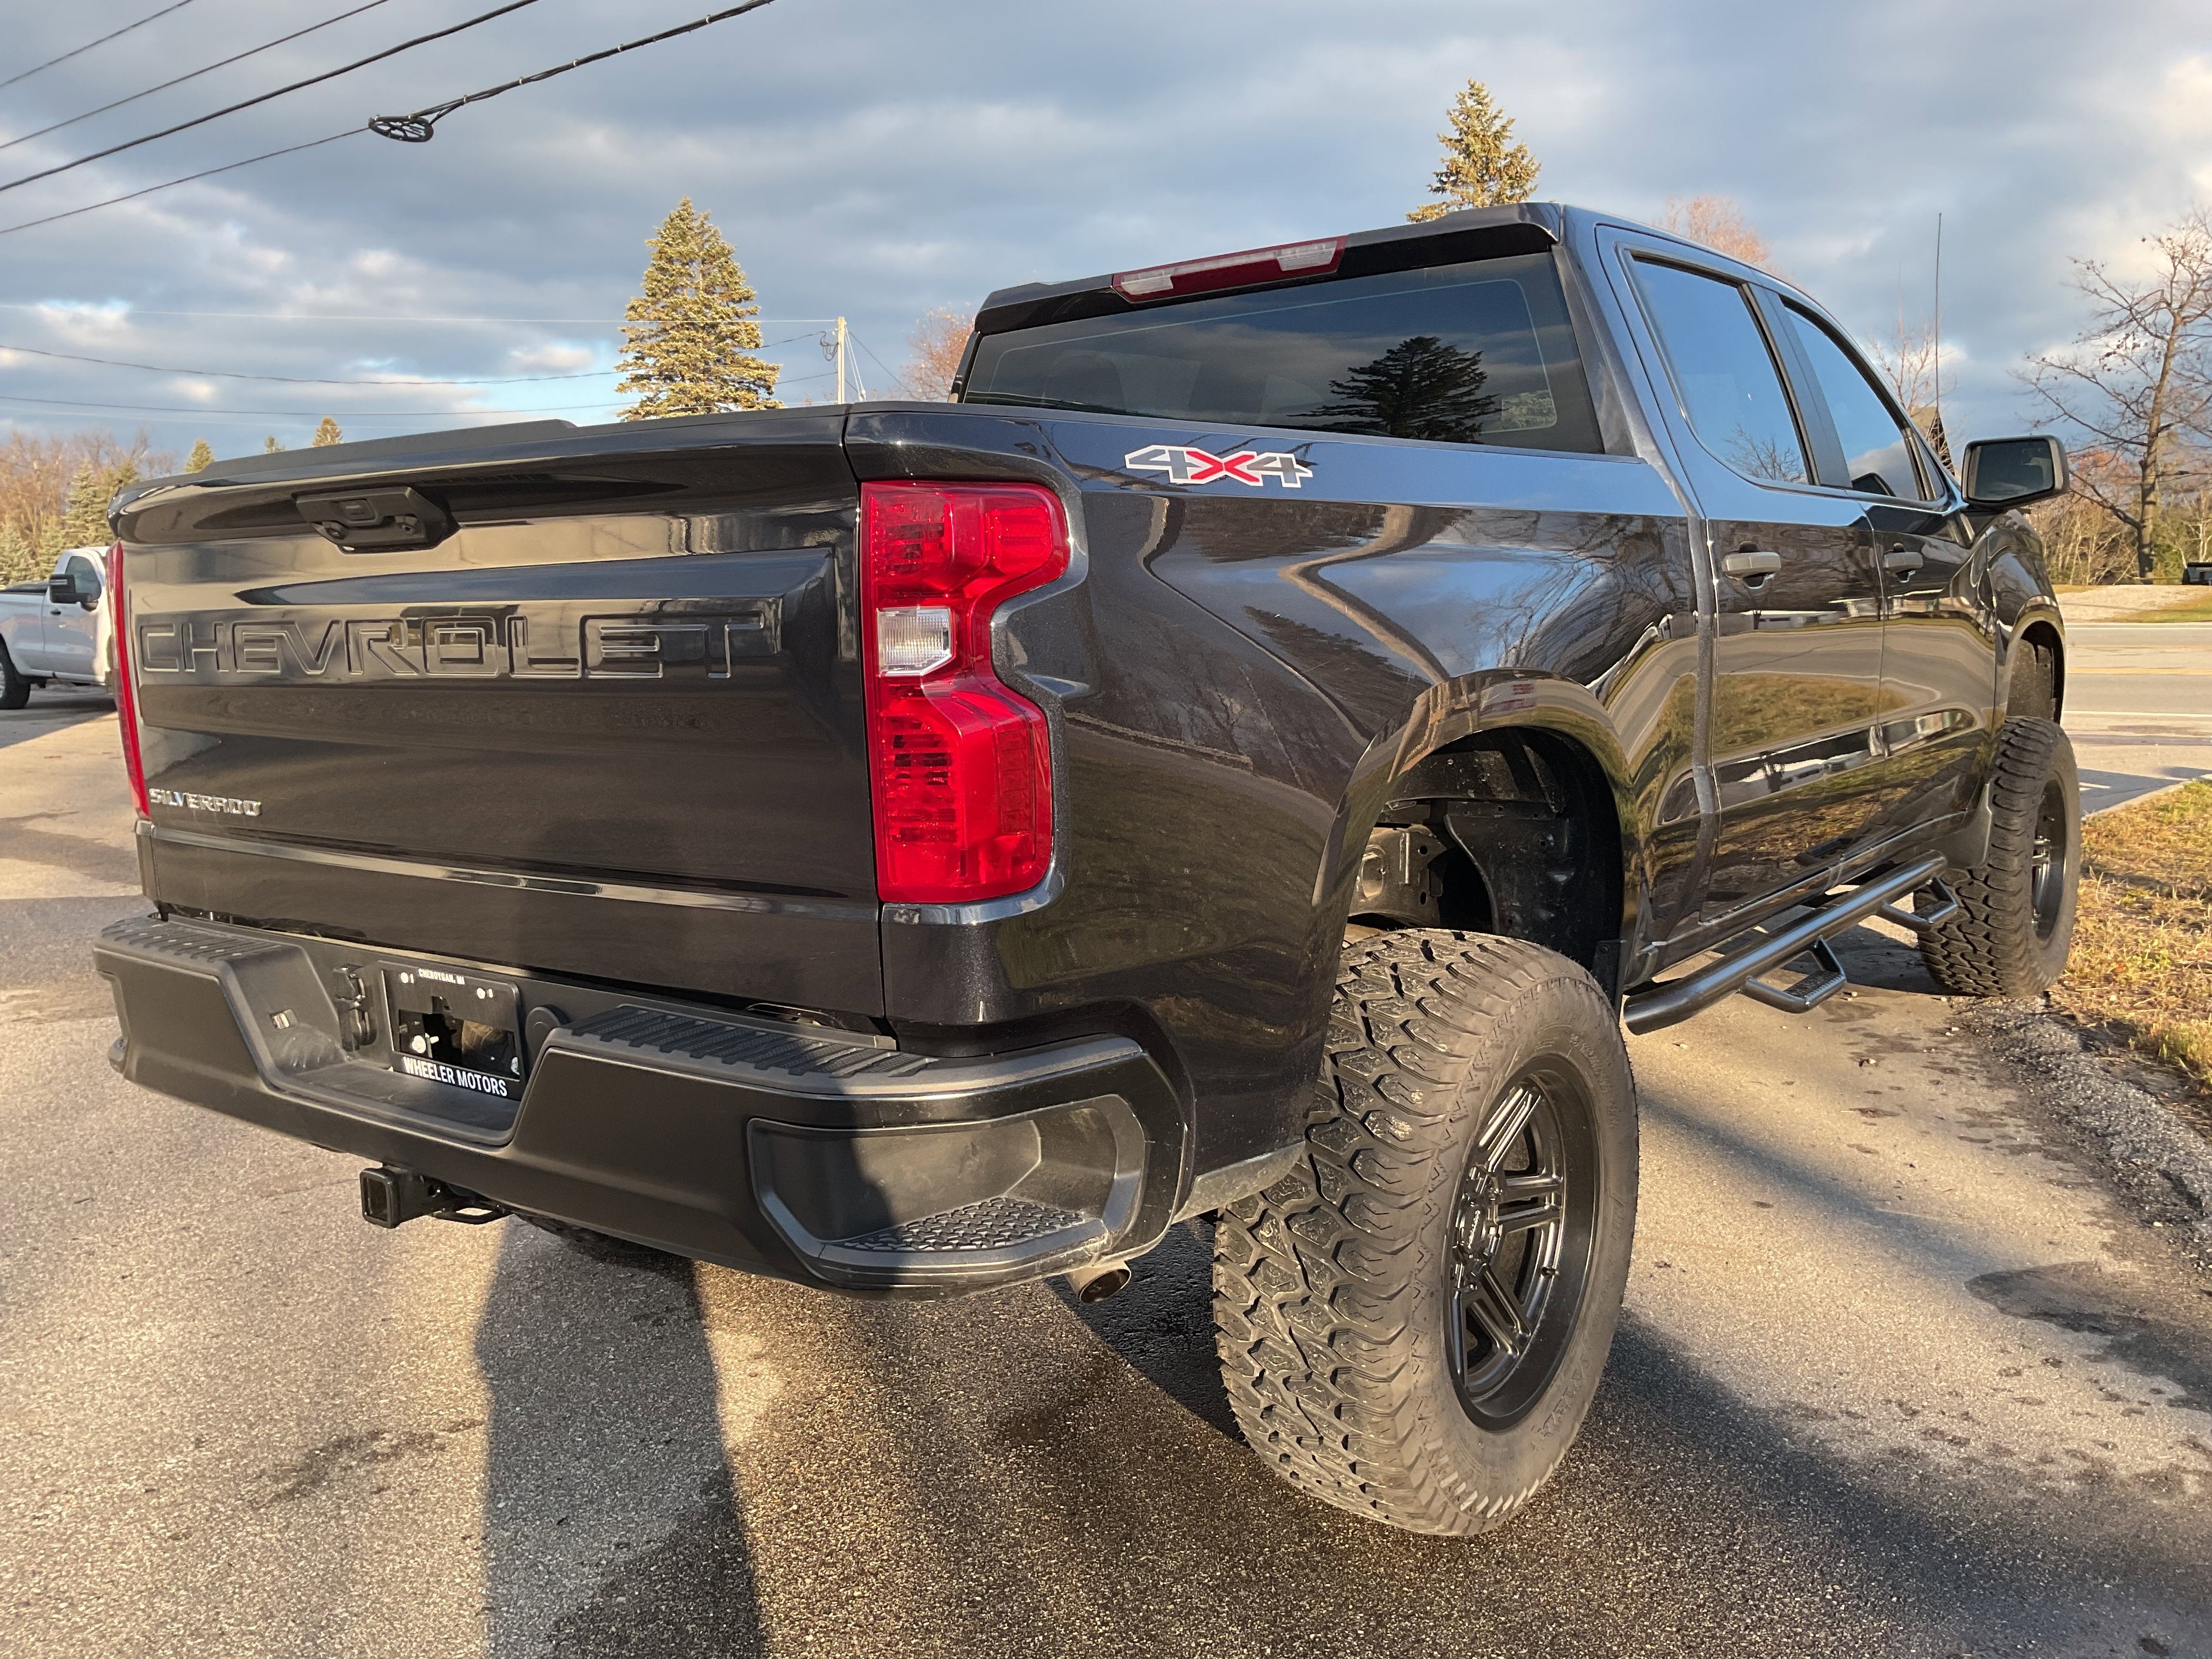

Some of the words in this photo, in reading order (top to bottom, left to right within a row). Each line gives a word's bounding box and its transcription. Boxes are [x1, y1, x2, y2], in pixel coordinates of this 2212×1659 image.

[139, 610, 766, 679] CHEVROLET
[149, 788, 262, 816] SILVERADO
[456, 975, 465, 985] MI
[403, 1056, 455, 1085] WHEELER
[456, 1069, 508, 1097] MOTORS
